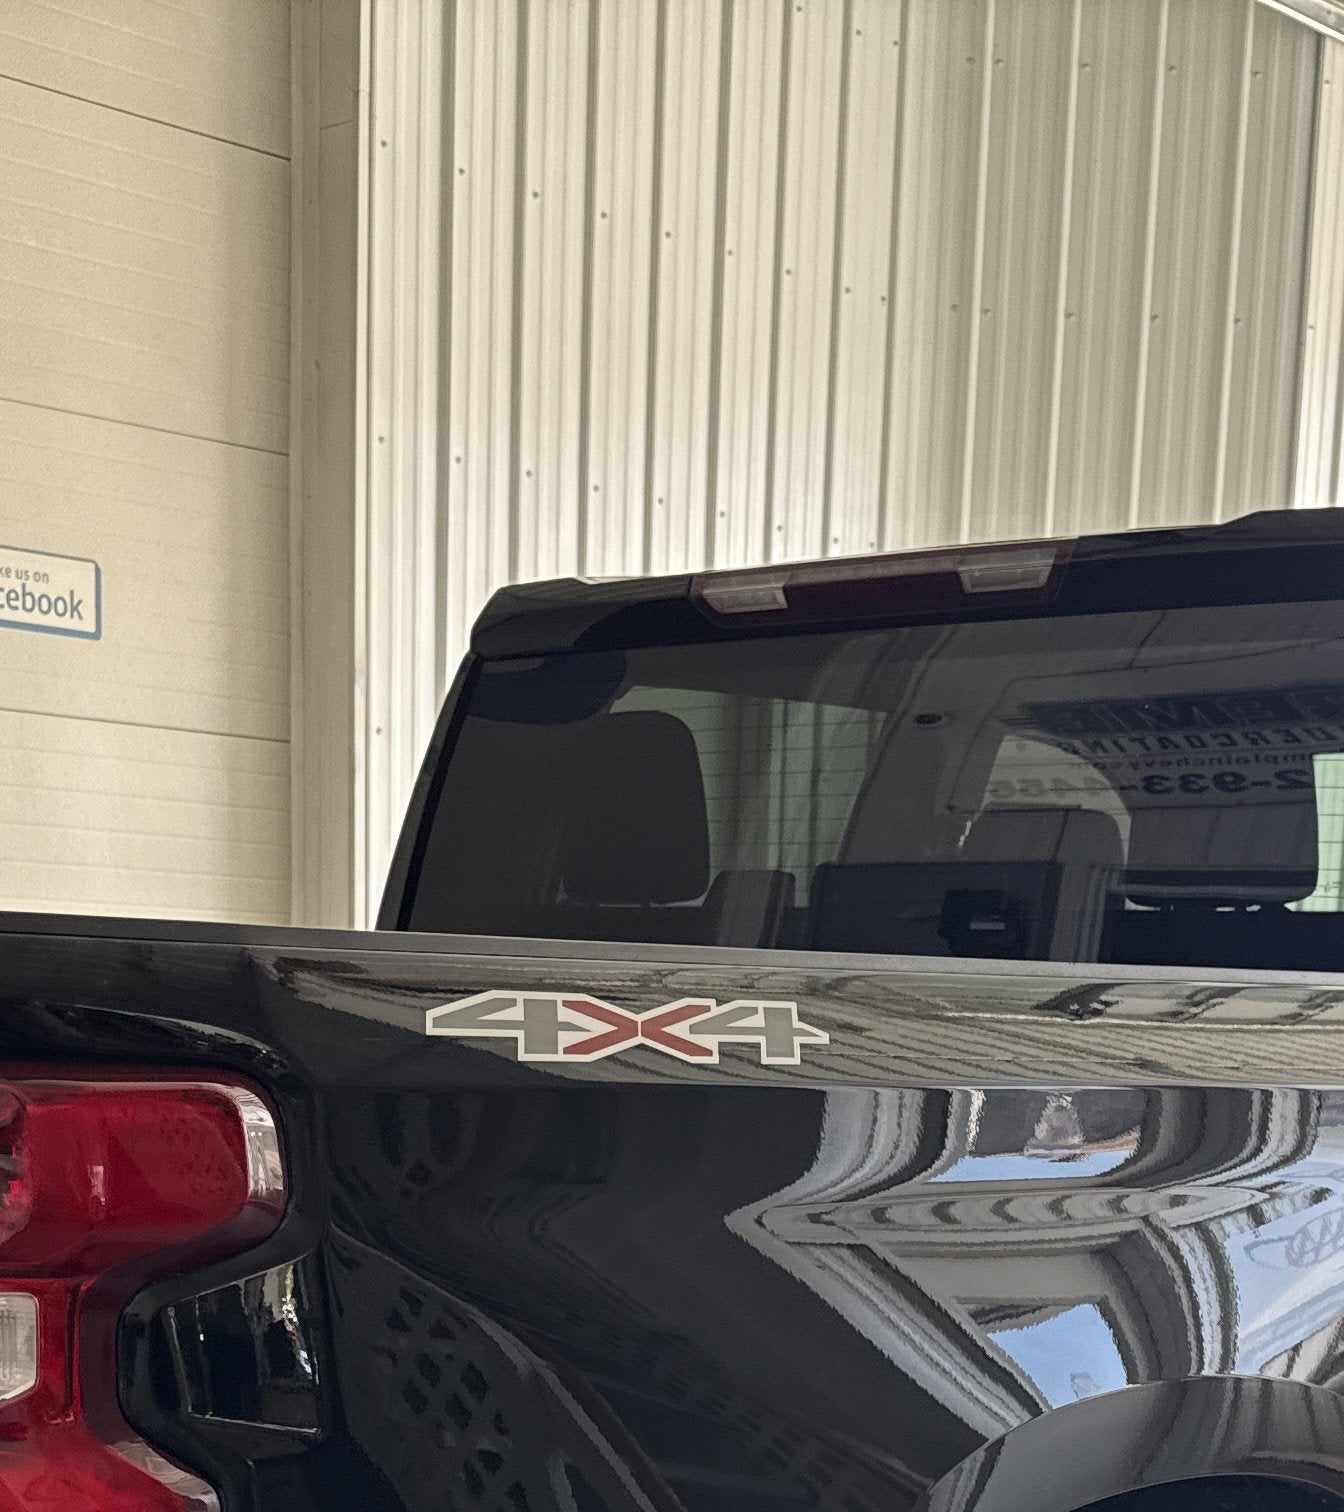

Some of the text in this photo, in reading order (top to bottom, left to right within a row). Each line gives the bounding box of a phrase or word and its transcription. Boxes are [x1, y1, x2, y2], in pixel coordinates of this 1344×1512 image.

[15, 564, 30, 581] us
[33, 570, 50, 584] on
[425, 989, 830, 1065] 4X4
